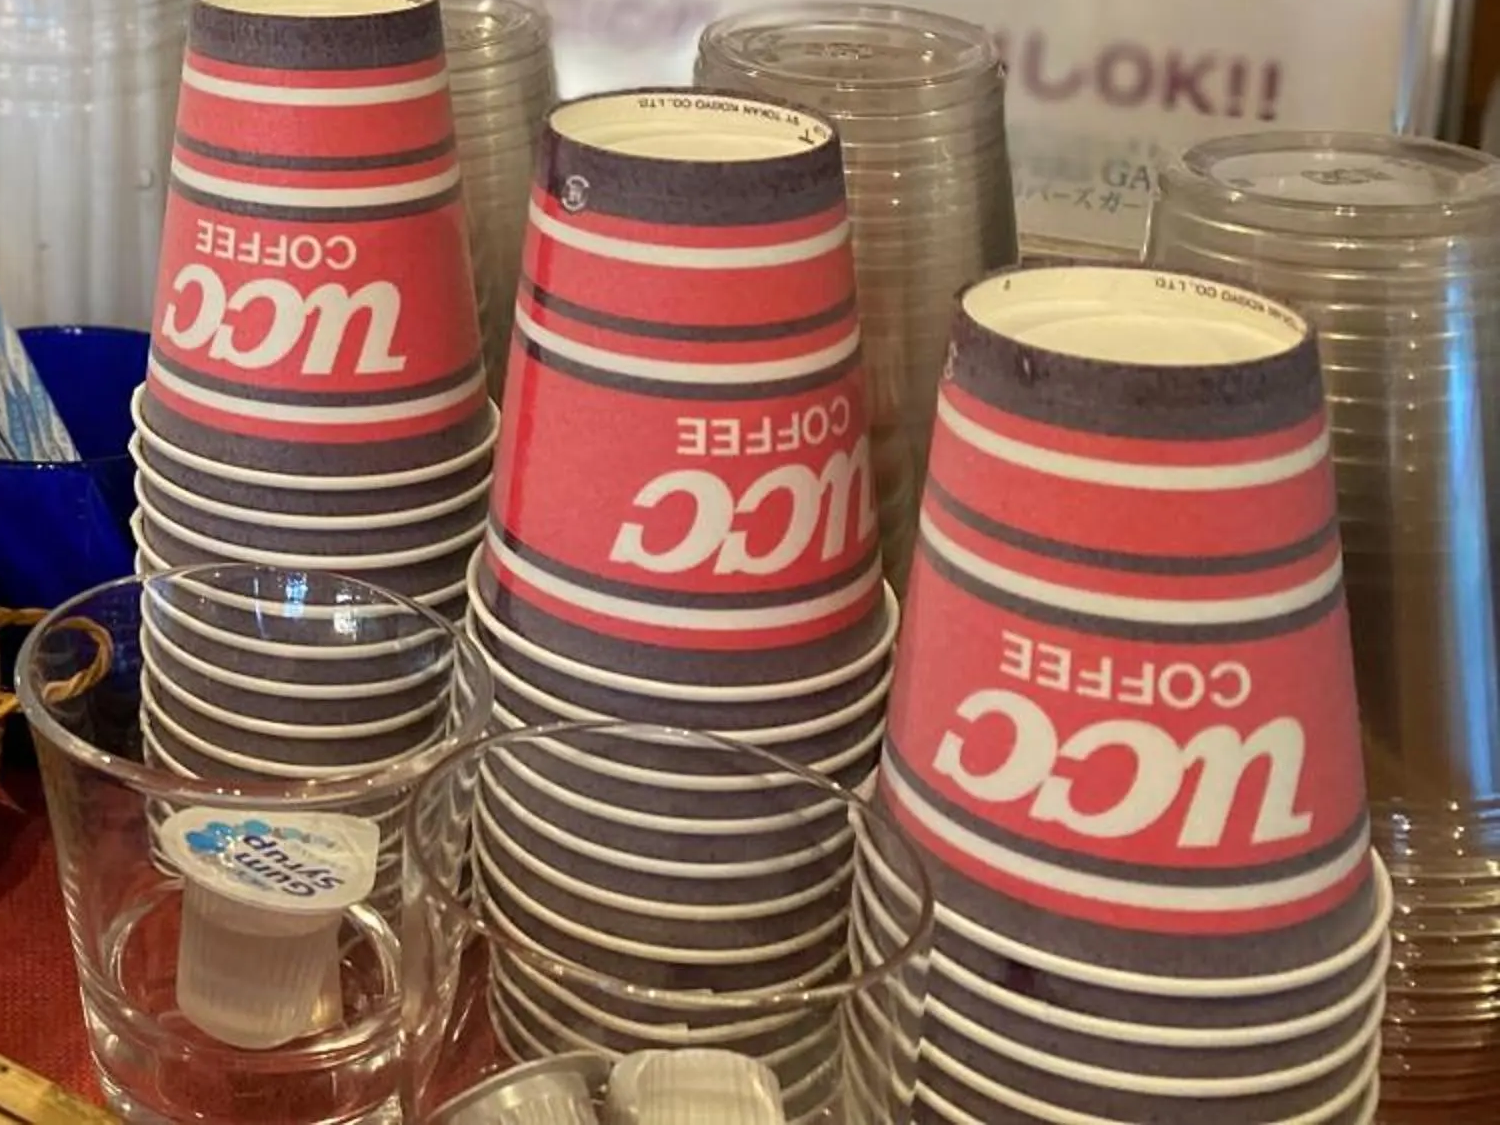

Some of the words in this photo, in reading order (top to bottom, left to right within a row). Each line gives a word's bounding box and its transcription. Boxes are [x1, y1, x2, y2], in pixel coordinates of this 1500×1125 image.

[1102, 158, 1152, 192] GA
[195, 218, 357, 270] COFFEE
[675, 395, 851, 456] COFFEE
[999, 629, 1252, 709] COFFEE
[234, 851, 317, 898] Gum
